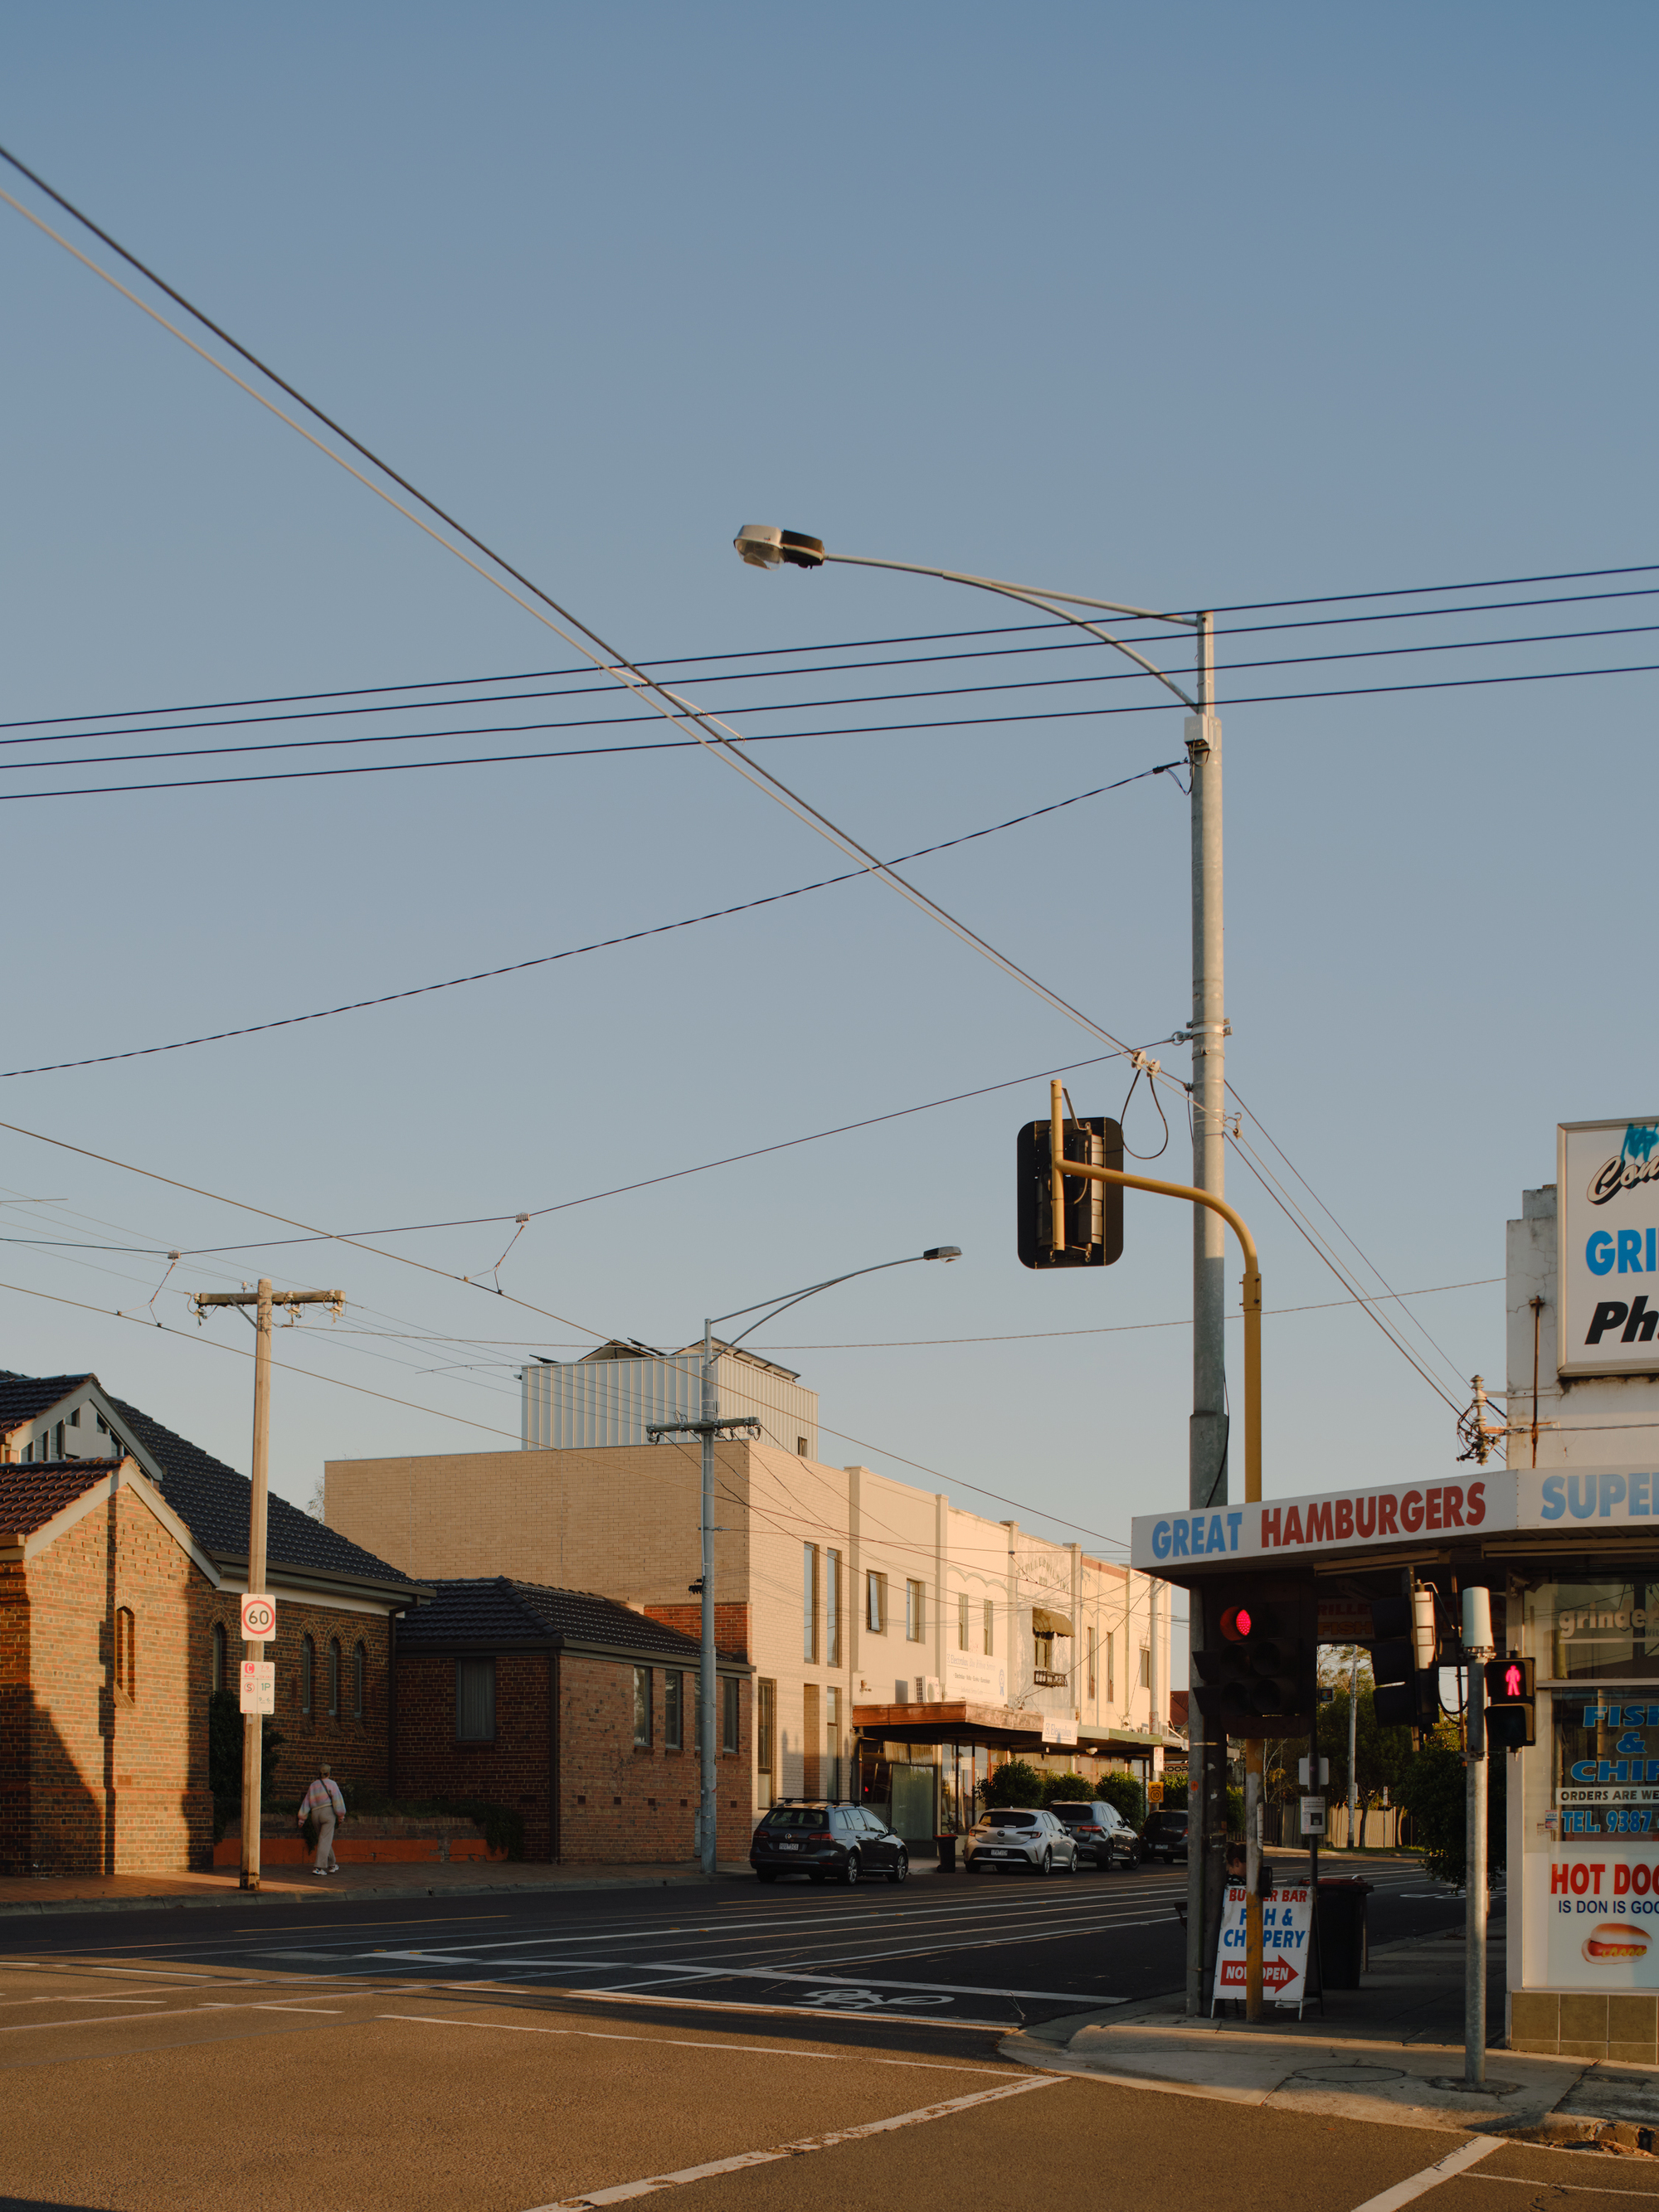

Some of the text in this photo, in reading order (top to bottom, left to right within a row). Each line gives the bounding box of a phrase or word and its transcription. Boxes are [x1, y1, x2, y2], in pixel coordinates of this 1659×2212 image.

[1585, 1228, 1659, 1276] GRI
[1151, 1481, 1486, 1559] GREAT HAMBURGERS
[1317, 1603, 1372, 1616] RILLE
[248, 1610, 270, 1625] 60
[1317, 1621, 1372, 1635] FISH
[261, 1683, 271, 1691] 1P
[1616, 1732, 1647, 1753] &
[1560, 1791, 1608, 1801] ORDERS
[1613, 1790, 1637, 1801] ARE
[1561, 1810, 1652, 1833] TEL. 9387
[1550, 1863, 1606, 1895] HOT
[1228, 1889, 1307, 1902] BUR BAR
[1558, 1900, 1572, 1913] IS
[1576, 1900, 1608, 1913] DON
[1613, 1900, 1627, 1913] IS
[1239, 1908, 1293, 1926] FH &
[1224, 1929, 1306, 1947] CHPERY
[1225, 1966, 1247, 1979] NO
